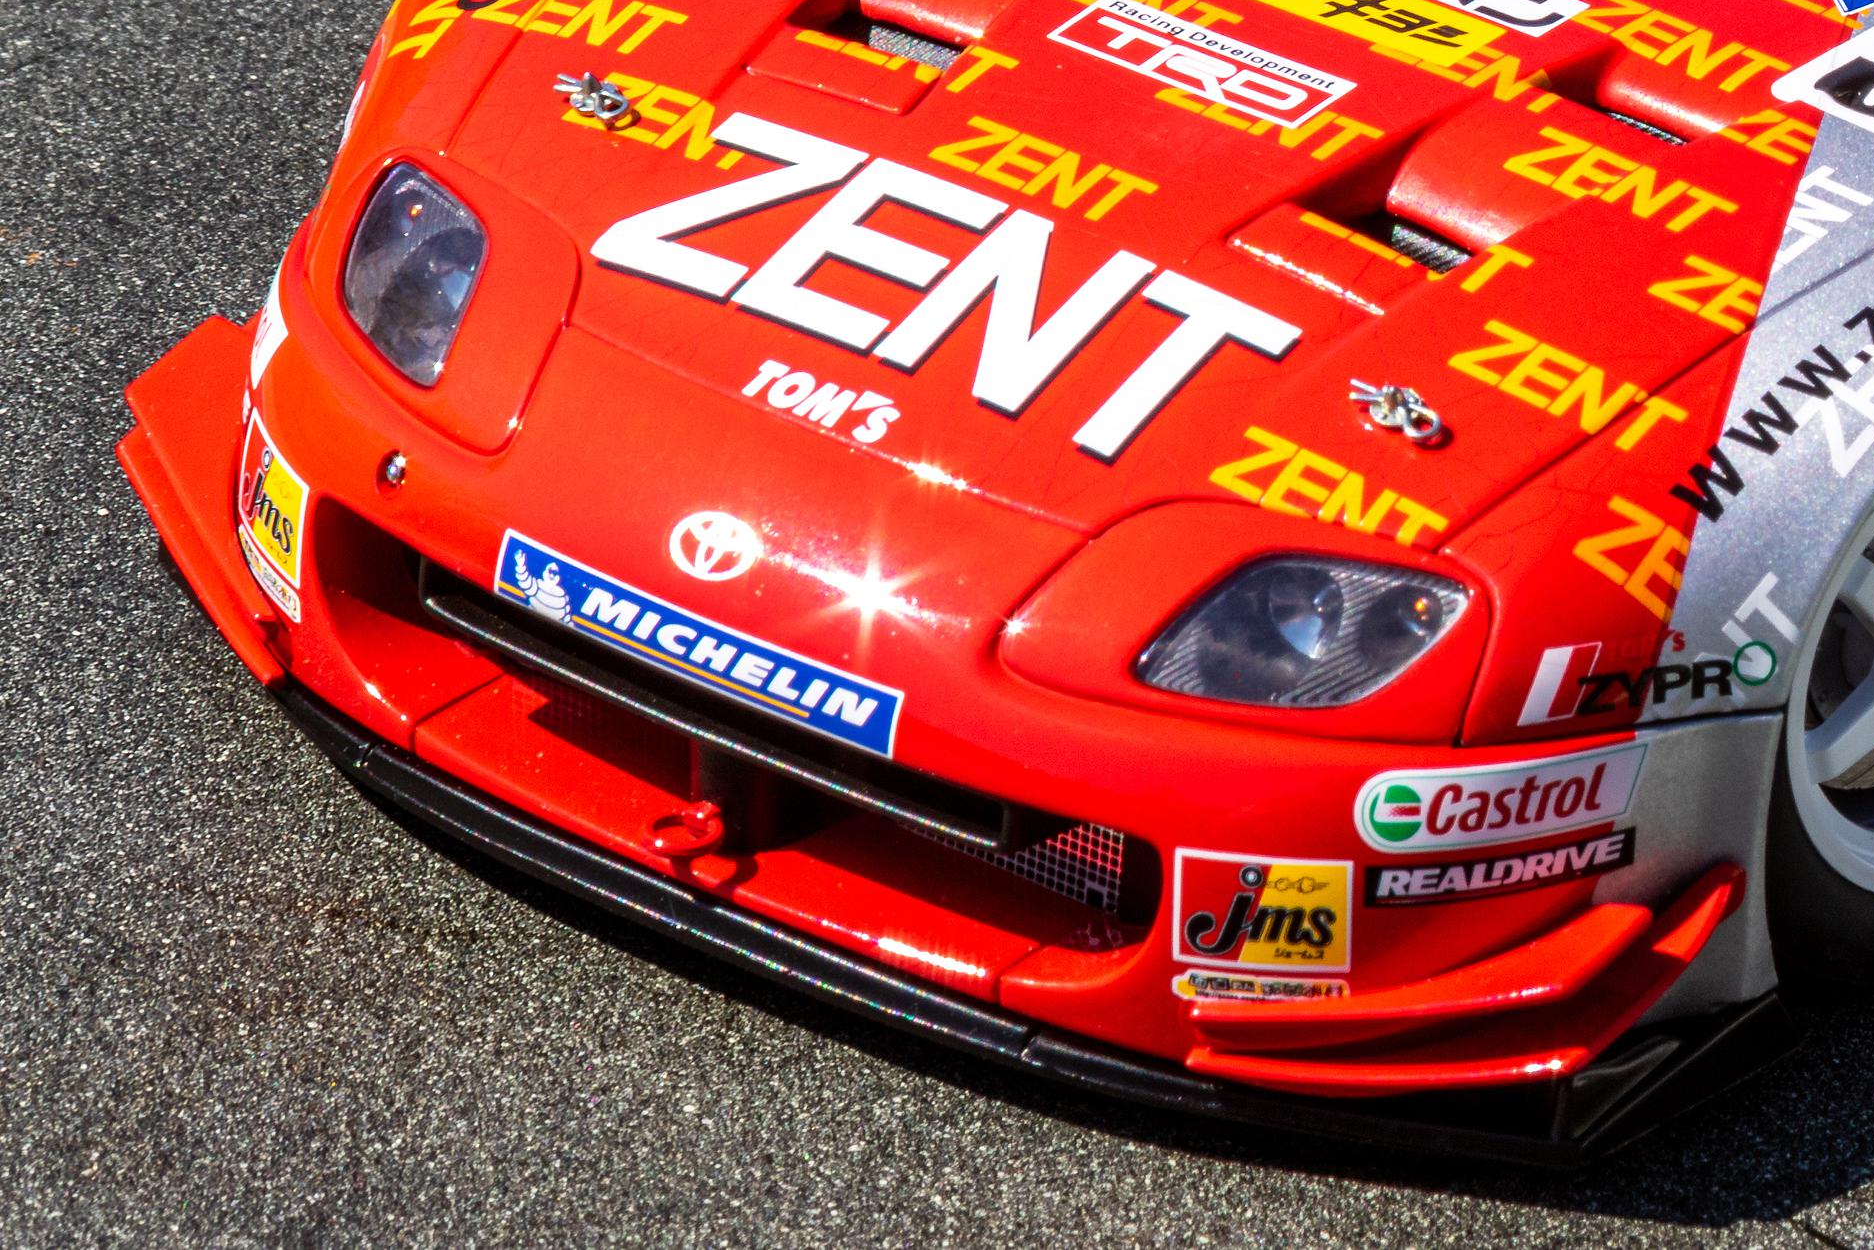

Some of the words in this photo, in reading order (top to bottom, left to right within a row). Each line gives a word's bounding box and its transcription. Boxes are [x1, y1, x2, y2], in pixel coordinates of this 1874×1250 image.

[1097, 15, 1310, 112] TRD
[1109, 0, 1185, 36] Racing
[1188, 27, 1337, 90] Development
[561, 71, 749, 171] ZEN
[929, 115, 1159, 224] ZENT
[1718, 109, 1820, 167] ZE
[1502, 124, 1741, 235] ZENT
[590, 112, 1303, 462] ZENT
[1647, 254, 1766, 334] ZE
[740, 359, 900, 444] TOM'S
[1447, 319, 1688, 454] ZENT
[1209, 426, 1452, 549] ZENT
[1571, 495, 1692, 625] ZE
[580, 586, 879, 728] MICHELIN
[1426, 763, 1606, 837] Castrol
[1184, 863, 1338, 957] jms
[1375, 832, 1626, 900] REALDRIVE
